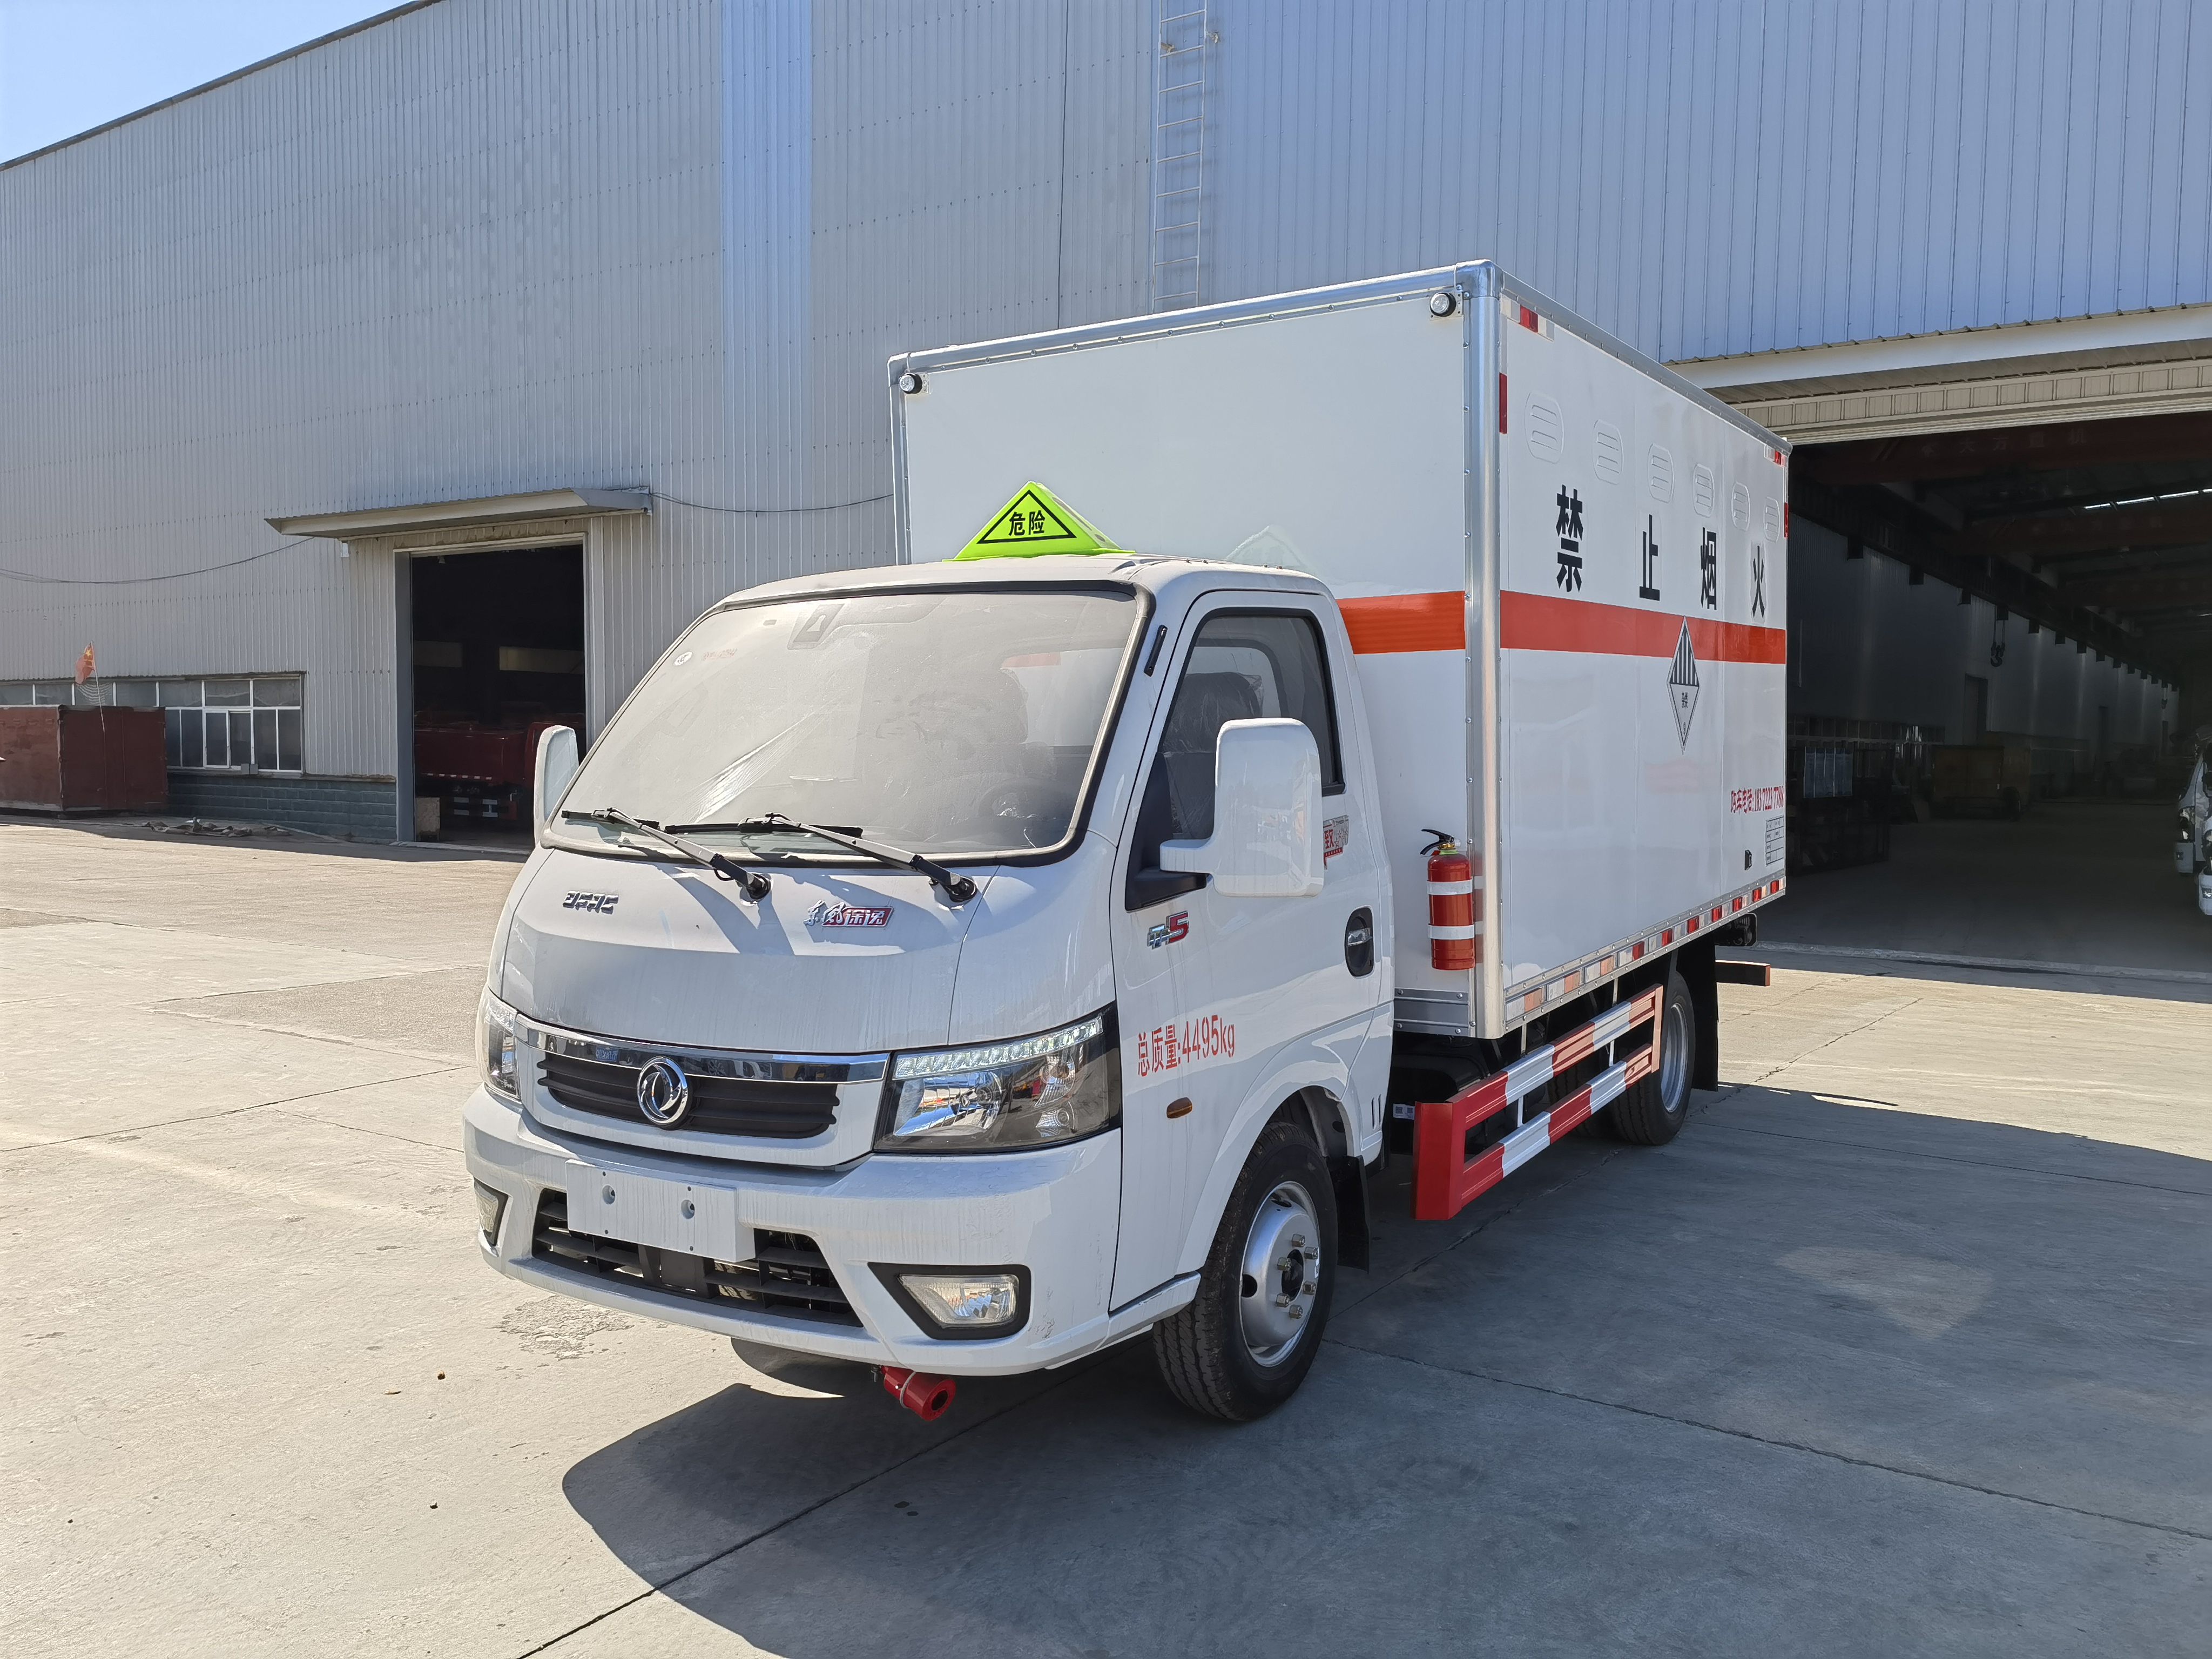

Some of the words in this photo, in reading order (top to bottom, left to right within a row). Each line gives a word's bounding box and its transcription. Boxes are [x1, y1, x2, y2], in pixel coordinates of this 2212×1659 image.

[1008, 510, 1046, 536] 危险
[1555, 484, 1765, 619] 禁止烟火
[1137, 1014, 1235, 1077] 总质量:4495kg
